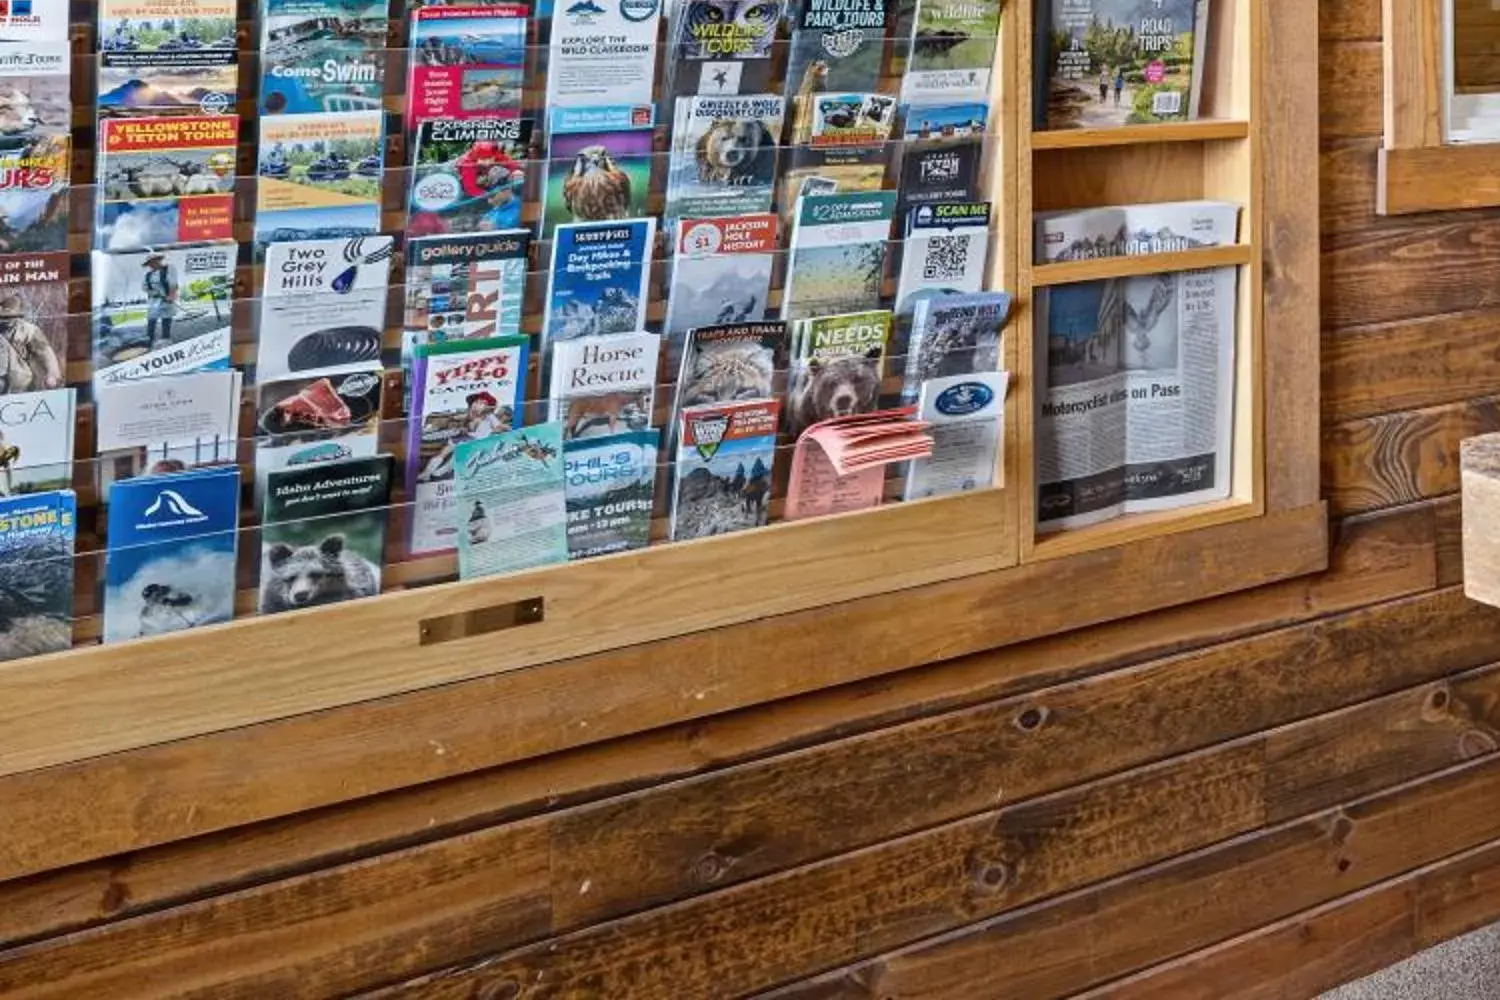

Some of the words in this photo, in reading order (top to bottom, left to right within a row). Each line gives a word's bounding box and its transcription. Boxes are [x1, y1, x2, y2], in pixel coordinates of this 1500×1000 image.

[804, 12, 840, 27] PARK
[843, 12, 885, 27] TOURS
[1141, 17, 1172, 33] ROAD
[693, 23, 766, 39] WILDLIFE
[699, 38, 753, 54] TOURS
[1139, 35, 1172, 50] TRIPS
[271, 65, 321, 78] Come
[323, 59, 376, 82] Swim
[114, 120, 231, 135] YELLOWSTONE
[431, 129, 521, 141] CLIMBING
[126, 131, 180, 144] TETON
[183, 129, 236, 141] TOURS
[935, 204, 969, 217] SCAN
[970, 203, 988, 216] ME
[725, 220, 769, 231] JACKSON
[723, 240, 766, 252] HISTORY
[287, 248, 326, 262] Two
[281, 260, 328, 274] Grey
[25, 271, 59, 282] MAN
[281, 275, 324, 289] Hills
[815, 323, 884, 346] NEEDS
[141, 350, 186, 373] YOUR
[582, 344, 644, 365] Horse
[571, 367, 645, 389] Rescue
[1131, 387, 1147, 400] on
[1151, 383, 1181, 398] Pass
[312, 472, 382, 492] Adventures
